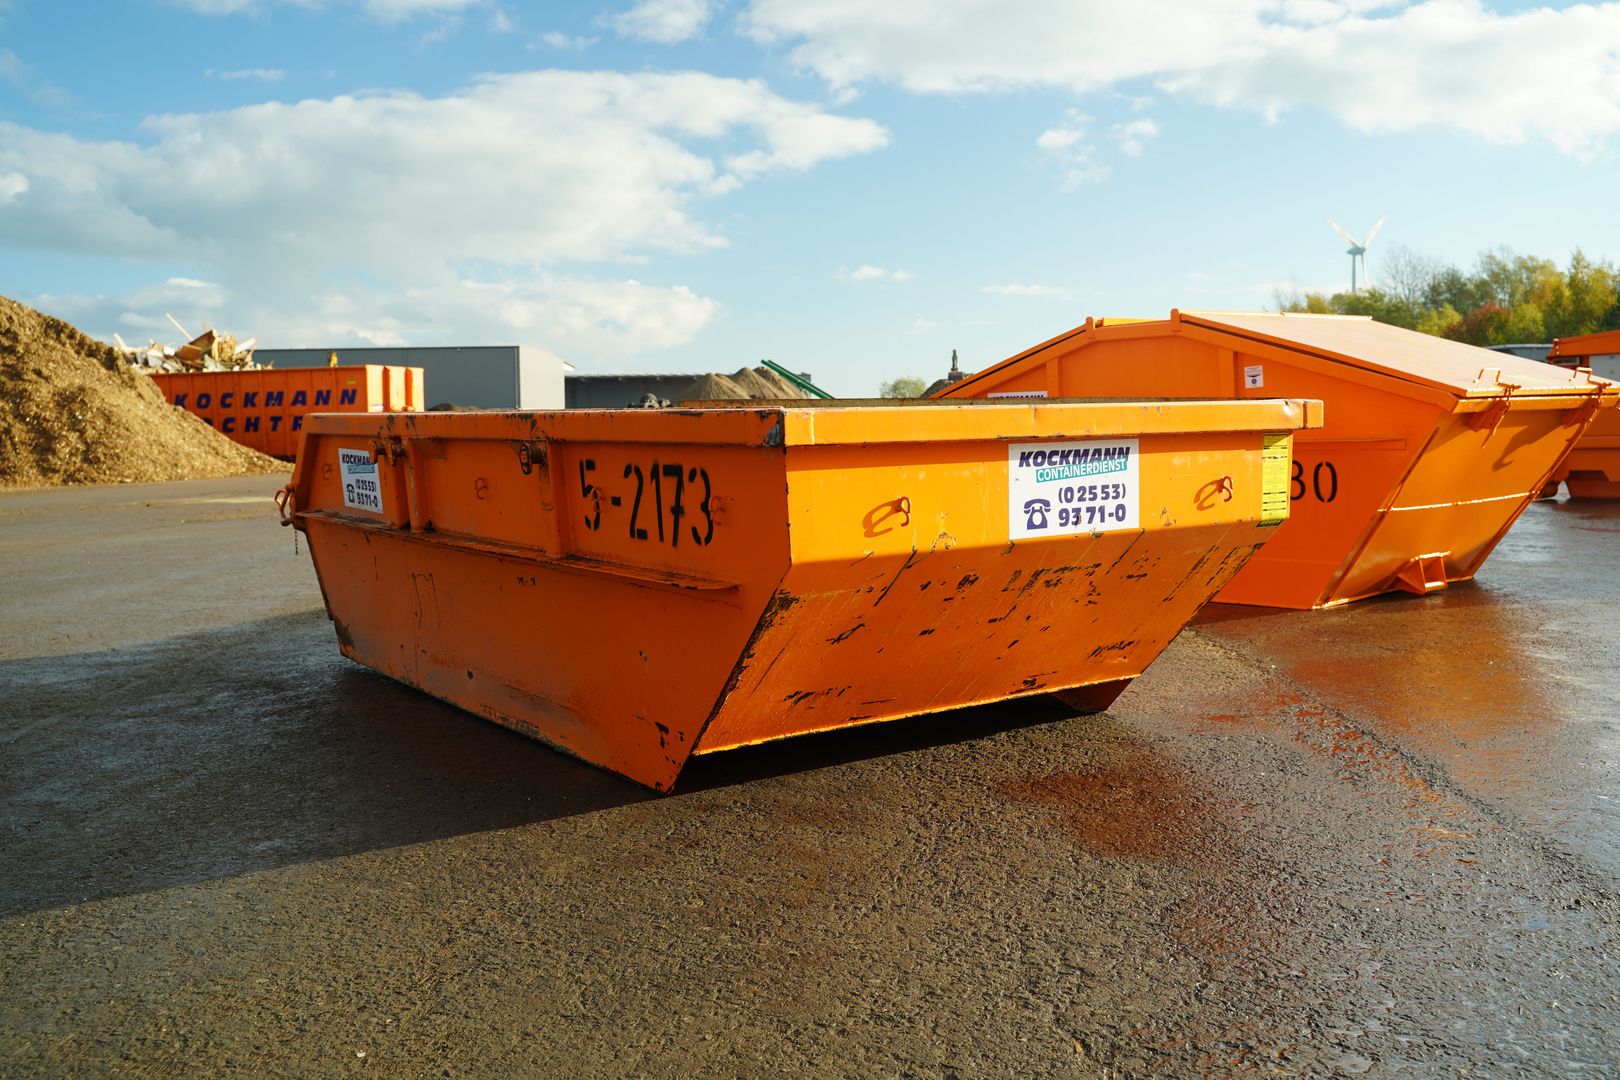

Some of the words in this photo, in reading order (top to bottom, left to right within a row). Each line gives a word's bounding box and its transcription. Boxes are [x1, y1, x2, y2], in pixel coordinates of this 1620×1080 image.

[174, 388, 358, 410] KOCKMANN
[1018, 446, 1131, 468] KOCKMANN
[1036, 459, 1127, 482] CONTAINERDIENST
[579, 459, 714, 548] 5-2173
